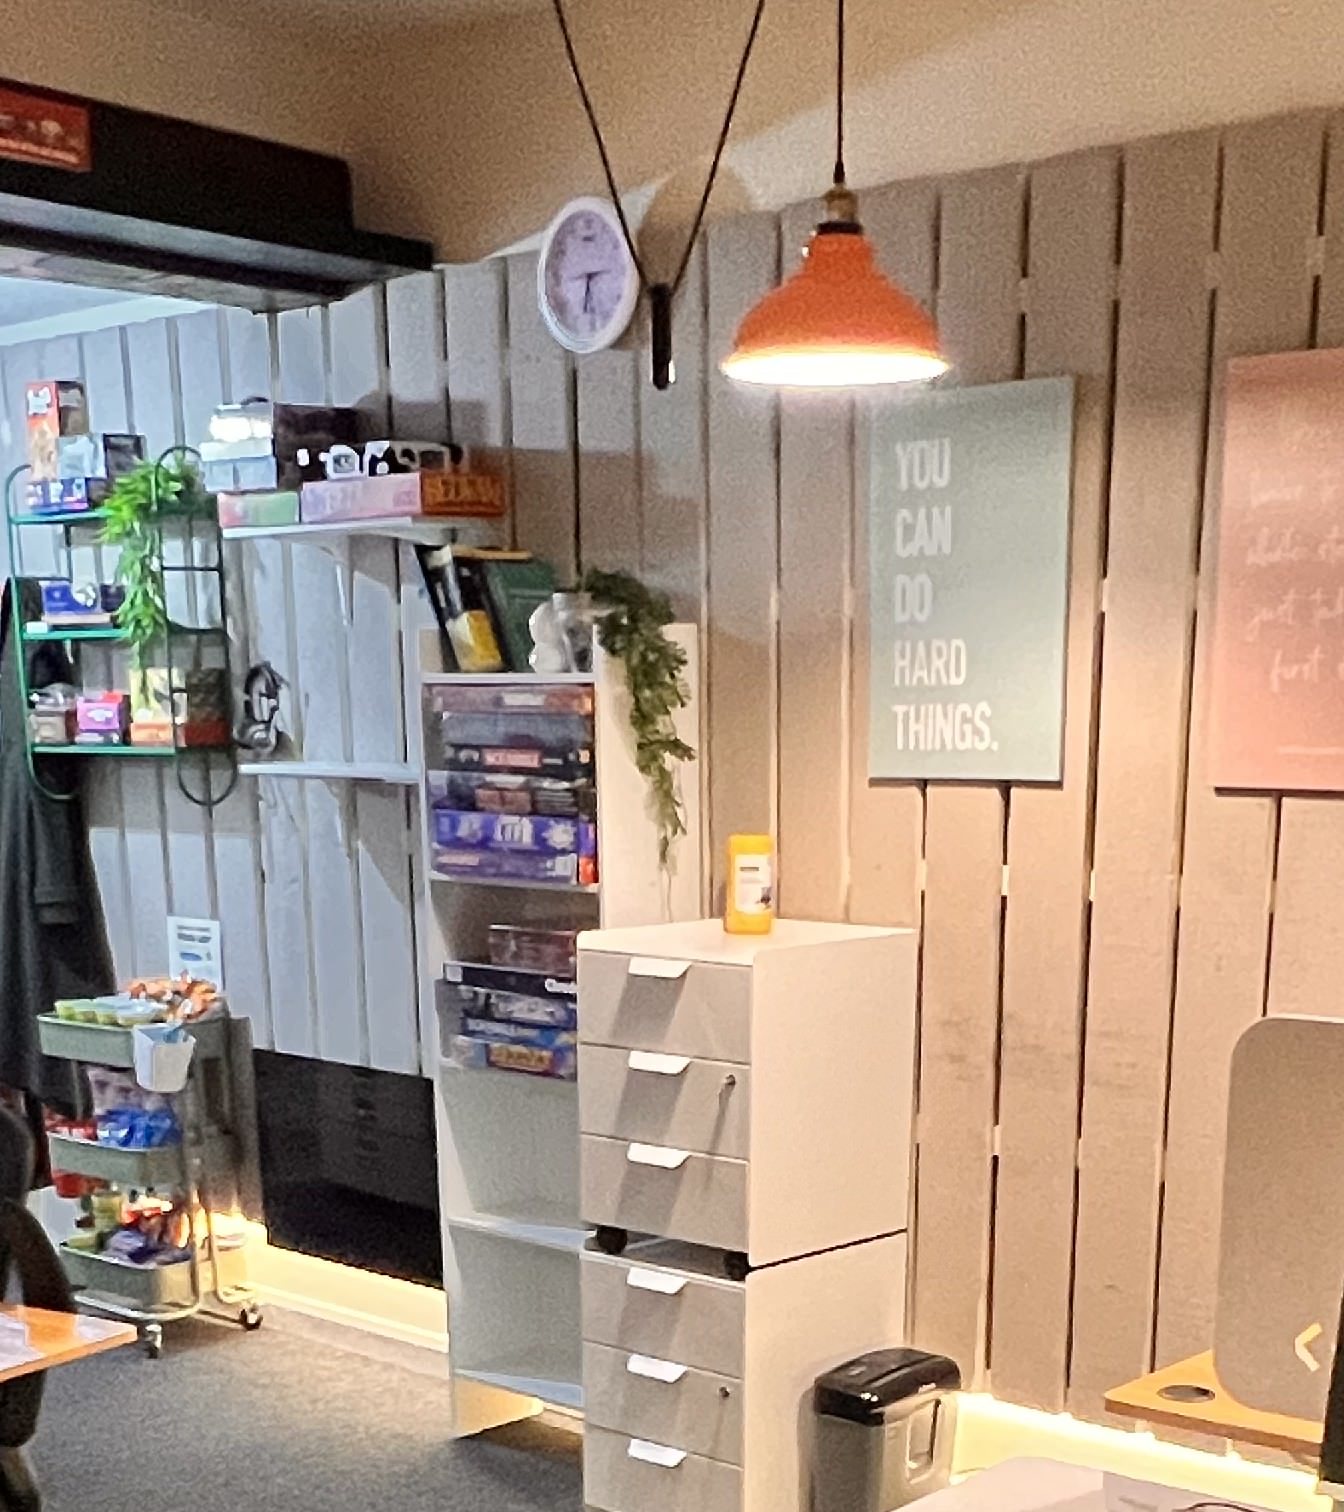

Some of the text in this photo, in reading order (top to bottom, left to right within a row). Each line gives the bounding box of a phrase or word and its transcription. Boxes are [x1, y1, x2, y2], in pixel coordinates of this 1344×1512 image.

[895, 437, 951, 491] YOU
[894, 505, 952, 558] CAN
[893, 573, 933, 624] DO
[892, 638, 967, 687] HARD
[890, 700, 999, 752] THINGS.
